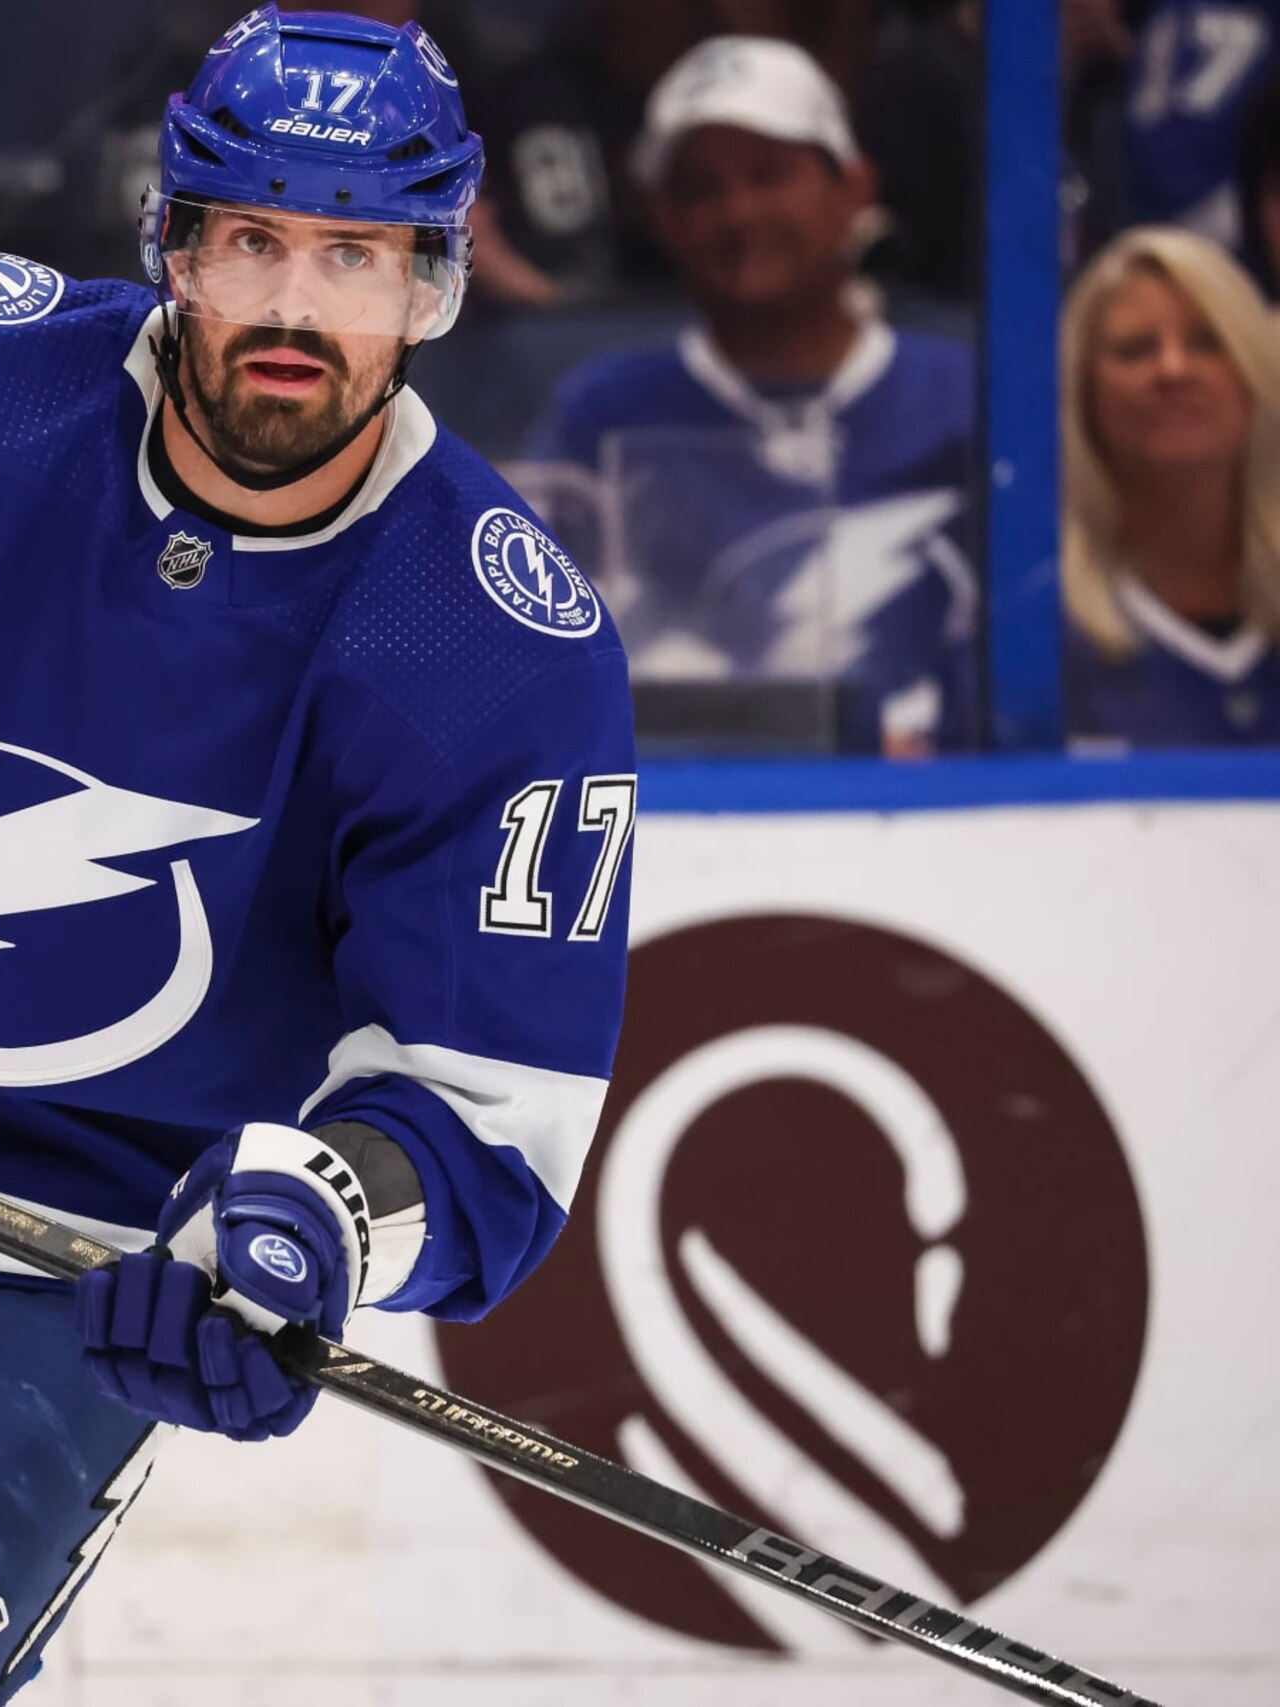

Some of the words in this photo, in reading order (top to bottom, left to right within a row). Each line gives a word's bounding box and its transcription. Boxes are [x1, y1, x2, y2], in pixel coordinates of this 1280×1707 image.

[301, 74, 364, 113] 17
[1130, 11, 1267, 126] 17
[271, 118, 371, 146] BAUER
[485, 516, 508, 548] BAY
[166, 551, 201, 573] NHL
[506, 515, 590, 600] LIGHTNING
[485, 554, 533, 616] TAMPA
[478, 773, 638, 942] 17
